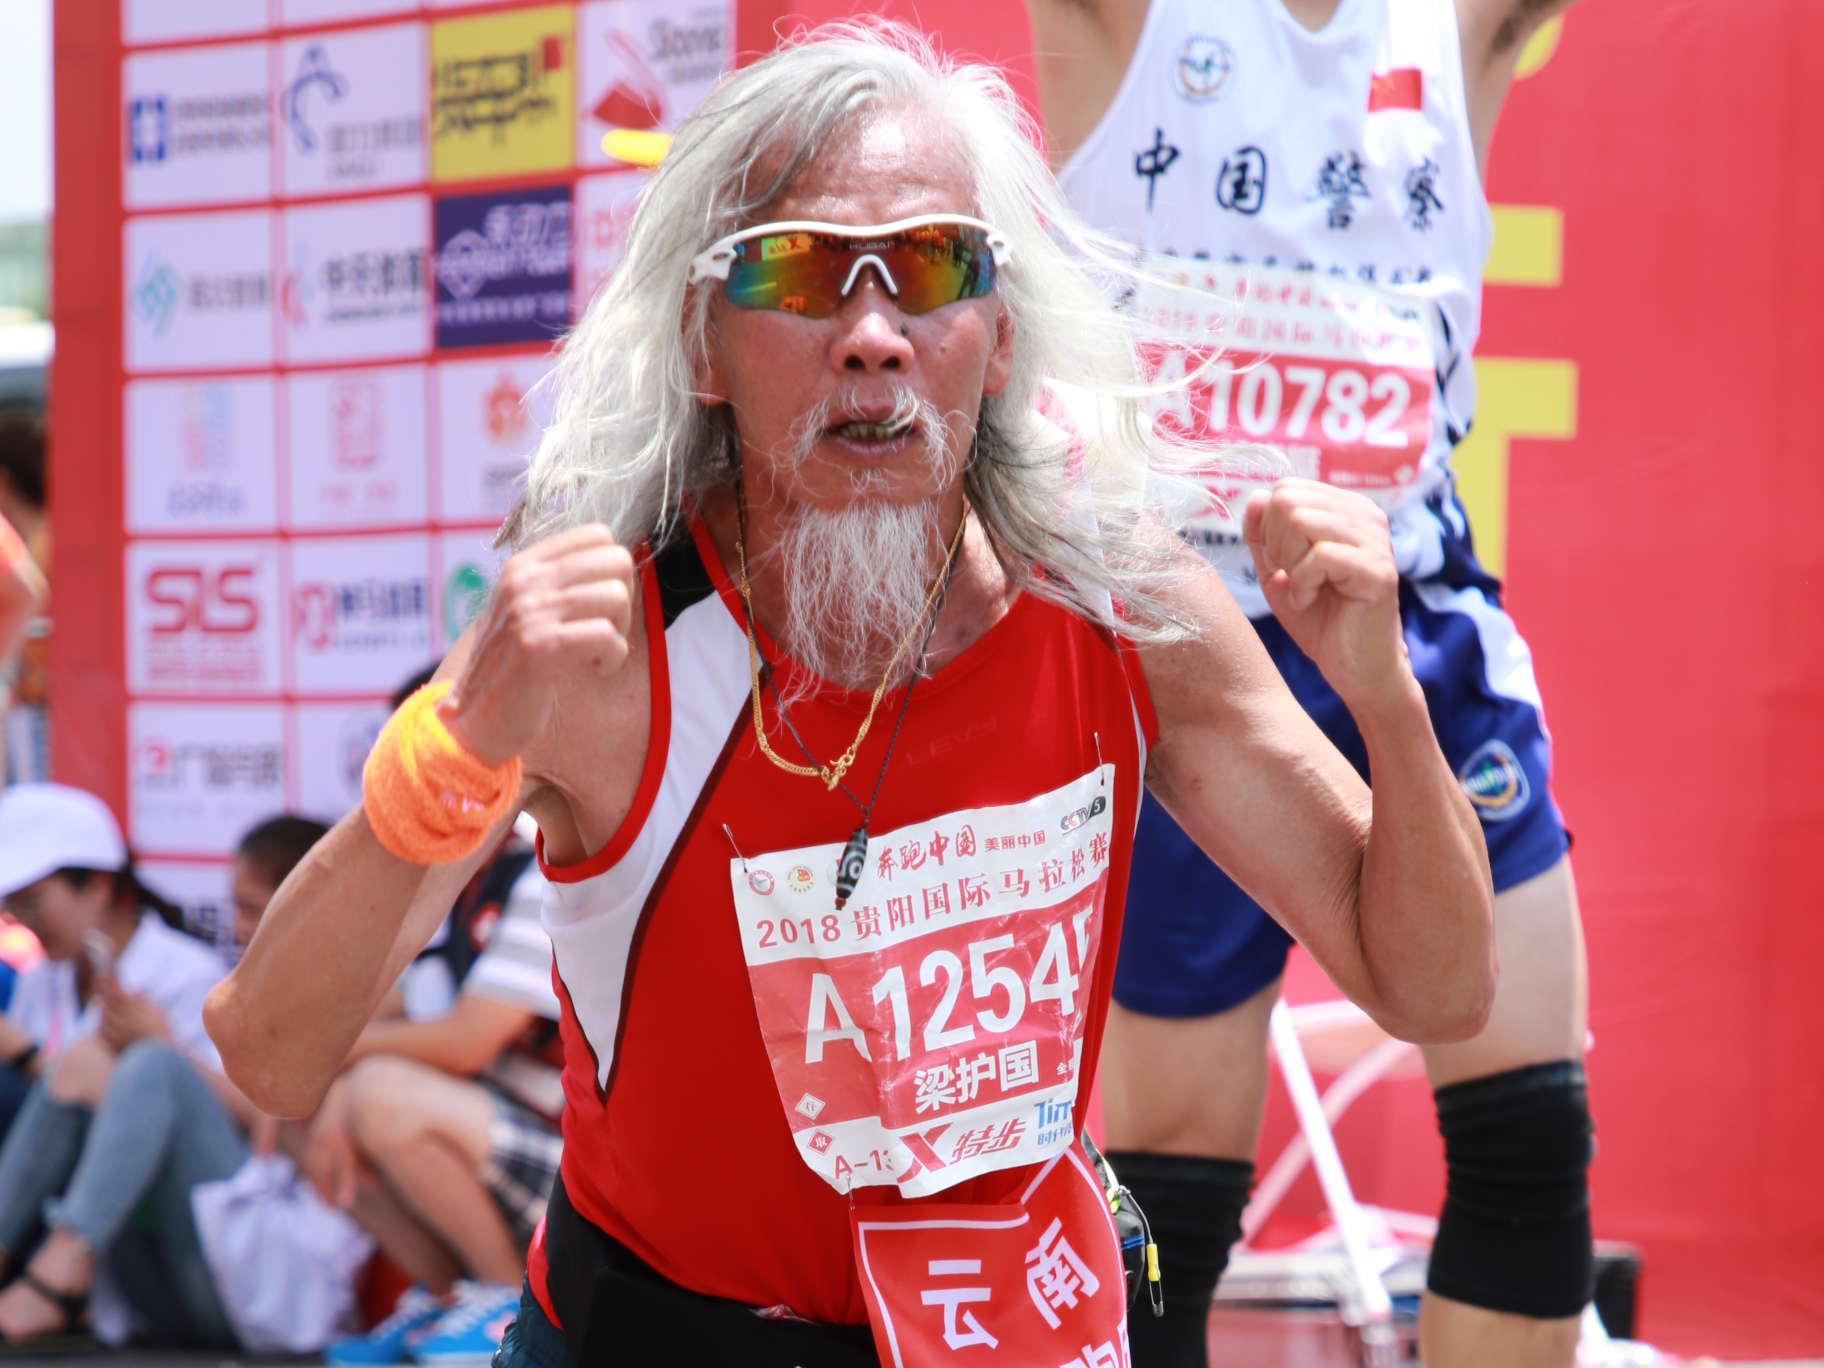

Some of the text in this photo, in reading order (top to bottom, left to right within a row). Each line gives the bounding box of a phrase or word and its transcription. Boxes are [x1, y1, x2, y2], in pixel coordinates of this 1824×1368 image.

[1135, 128, 1443, 231] 中国警察
[1150, 352, 1412, 448] A10782
[877, 824, 977, 881] 奔跑中国
[985, 829, 1046, 852] 美丽中国
[914, 1040, 1039, 1114] 梁护国
[949, 1117, 1027, 1165] 特步
[921, 1217, 1100, 1350] 云南
